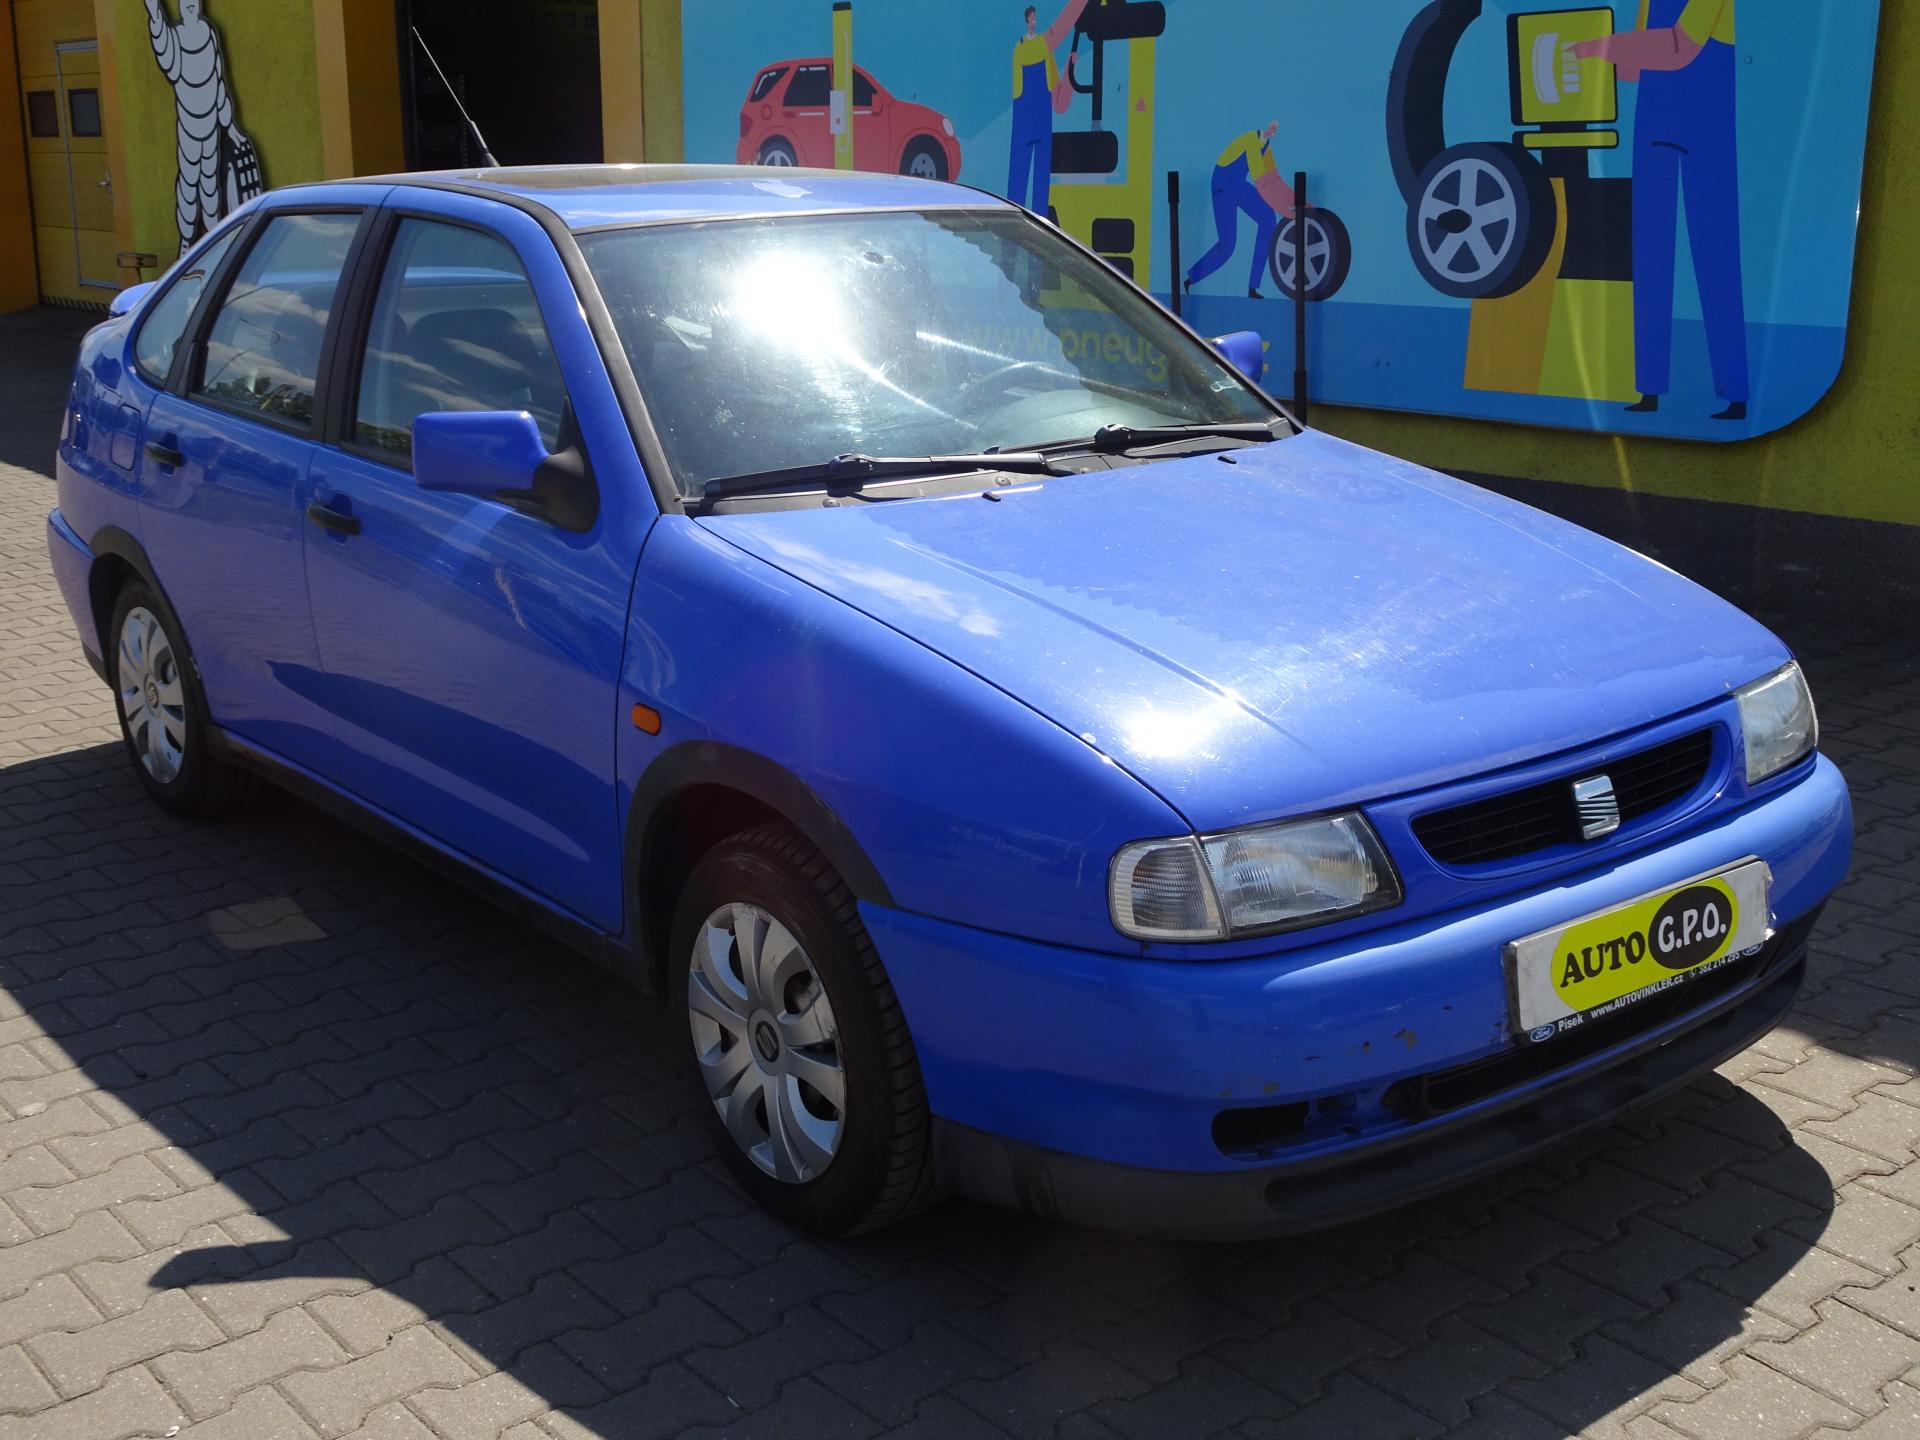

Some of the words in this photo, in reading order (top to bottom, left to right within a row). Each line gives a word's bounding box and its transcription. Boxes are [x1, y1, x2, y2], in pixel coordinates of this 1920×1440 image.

[1559, 930, 1646, 989] AUTO
[1657, 902, 1727, 953] G.P.O.
[1590, 974, 1684, 1019] www.AUTOVINKLER.cz
